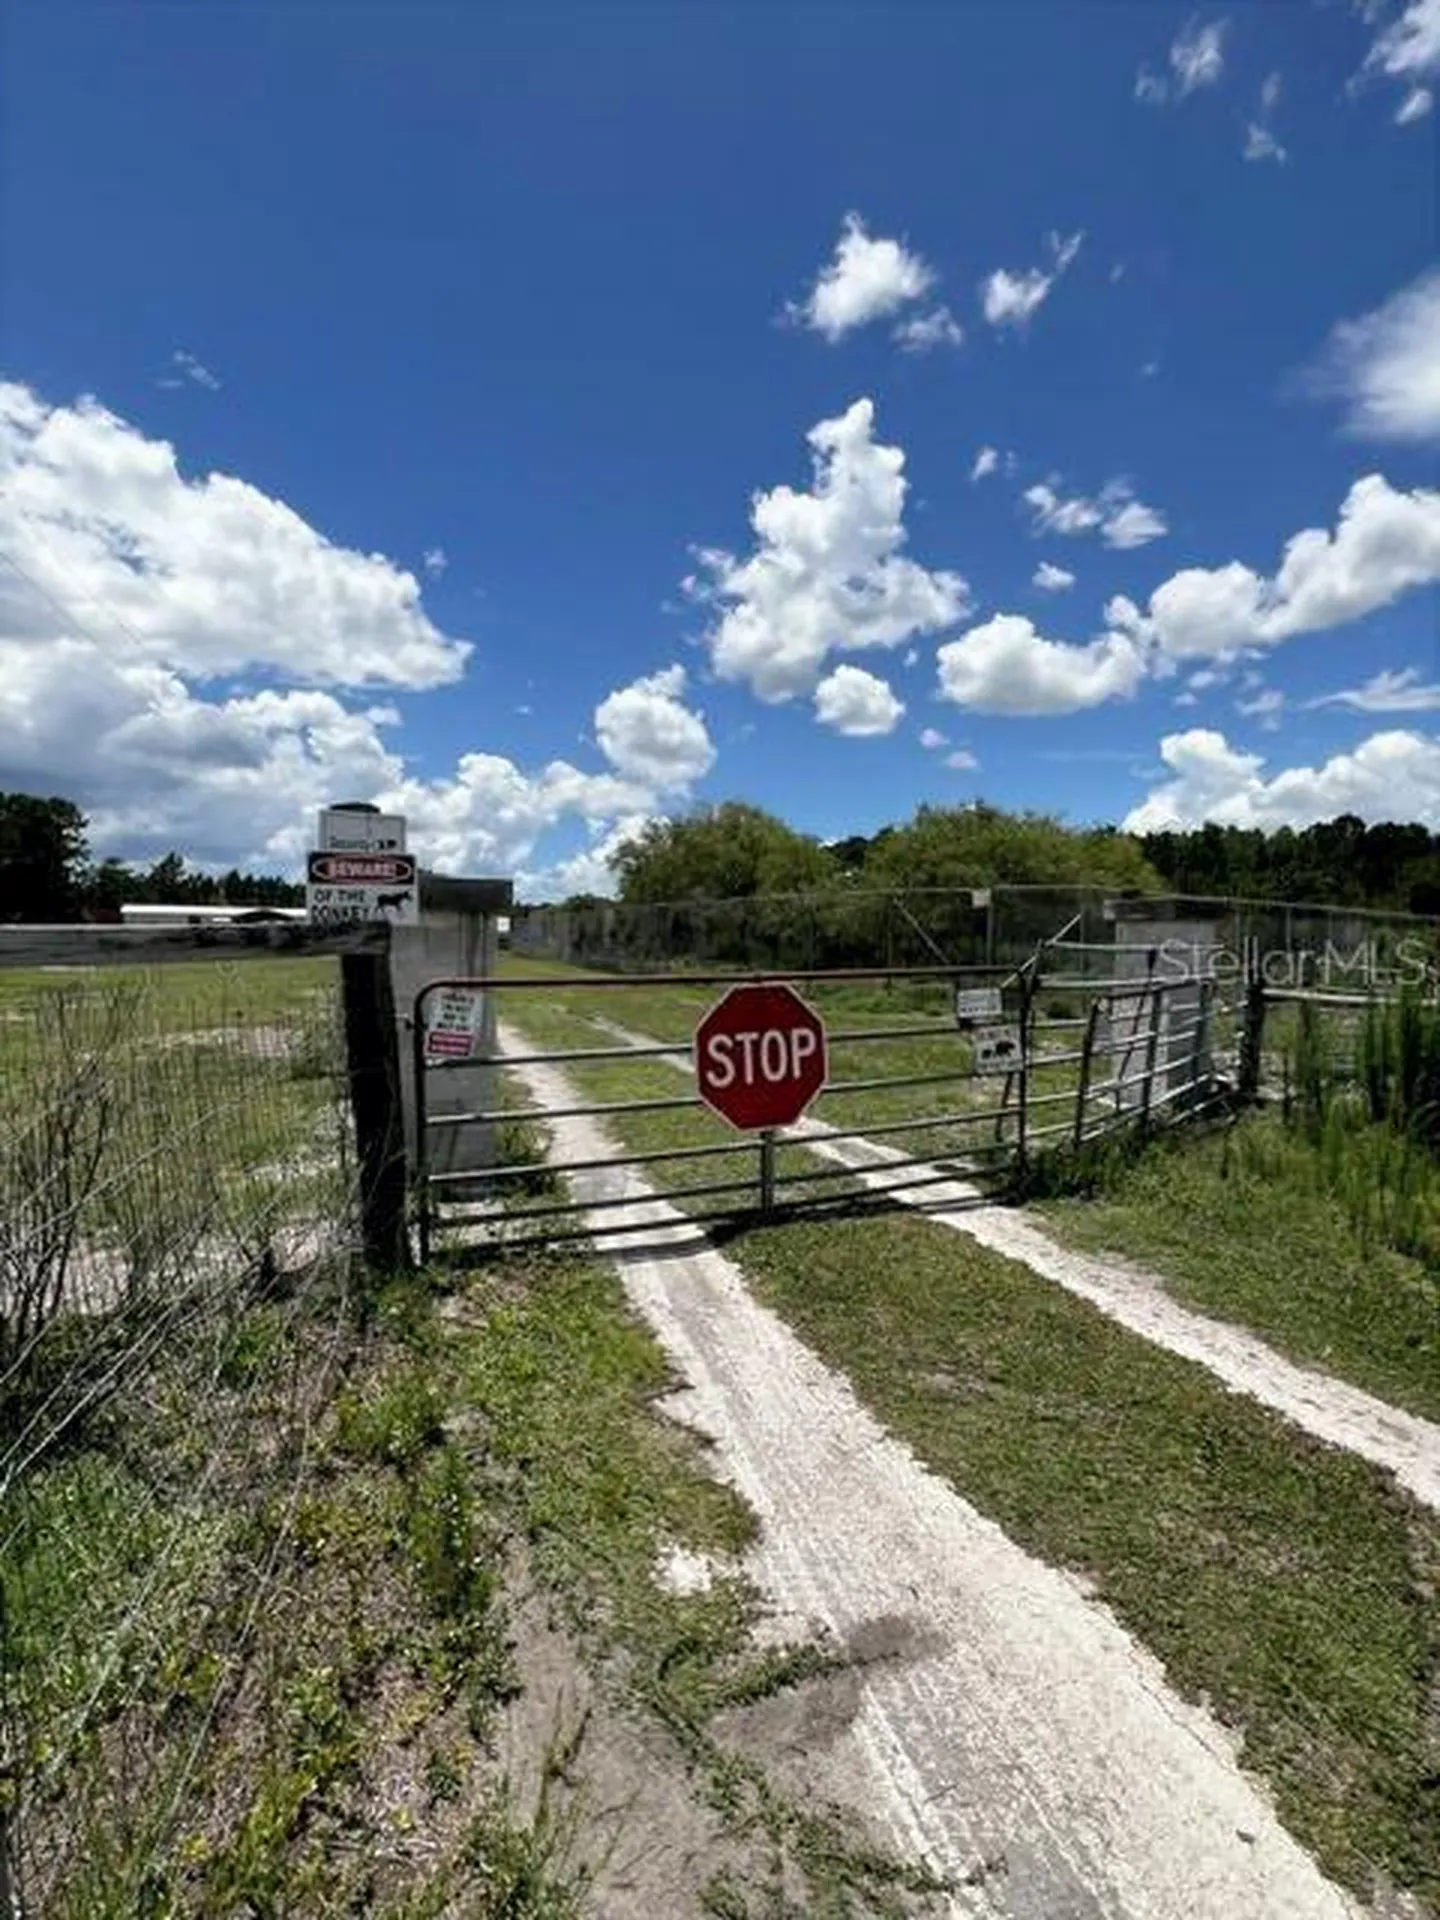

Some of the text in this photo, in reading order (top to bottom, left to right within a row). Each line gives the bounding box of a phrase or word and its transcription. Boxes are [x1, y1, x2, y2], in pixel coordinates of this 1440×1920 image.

[313, 888, 365, 903] OF THE
[706, 1027, 817, 1088] STOP
